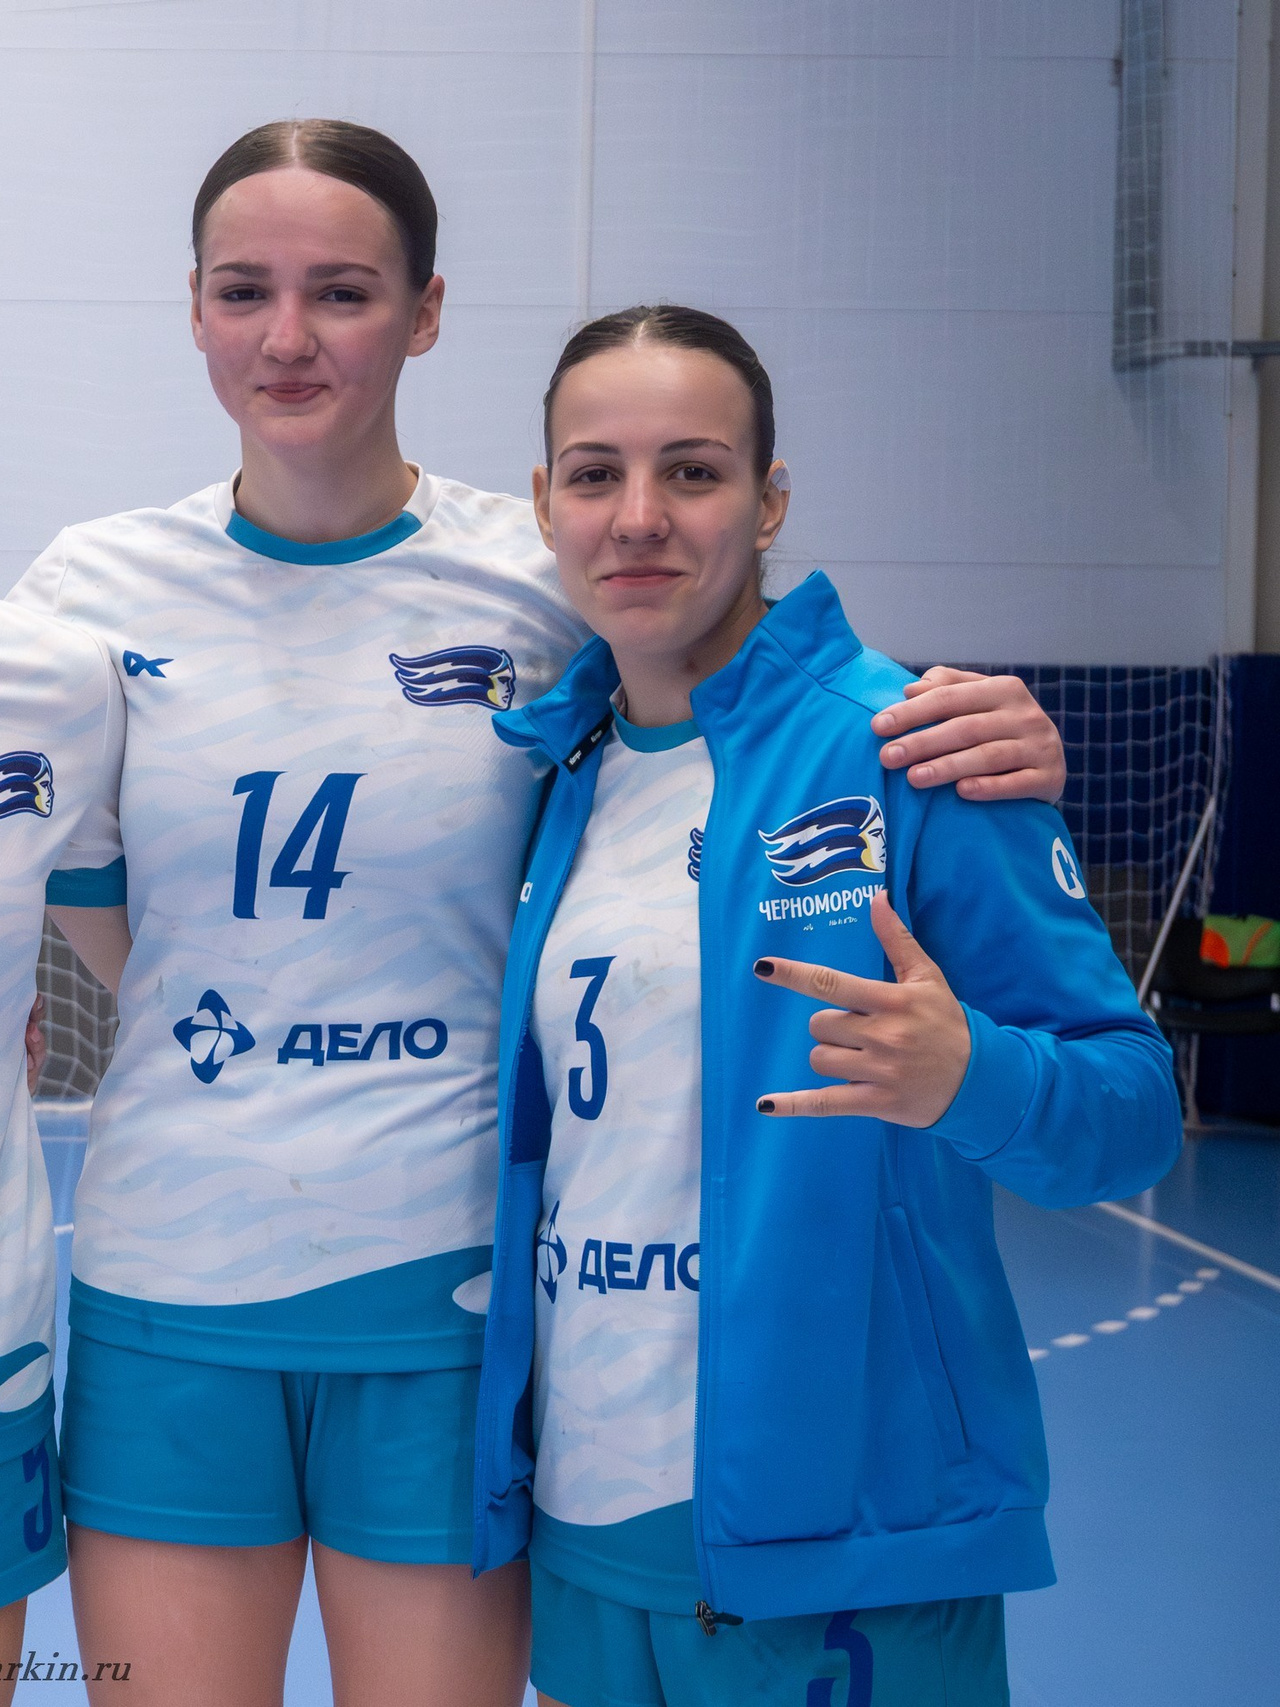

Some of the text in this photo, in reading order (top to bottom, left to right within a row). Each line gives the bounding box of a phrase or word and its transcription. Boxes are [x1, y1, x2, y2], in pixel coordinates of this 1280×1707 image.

[232, 770, 368, 920] 14
[277, 1017, 449, 1067] ДЕЛО
[568, 955, 617, 1121] 3
